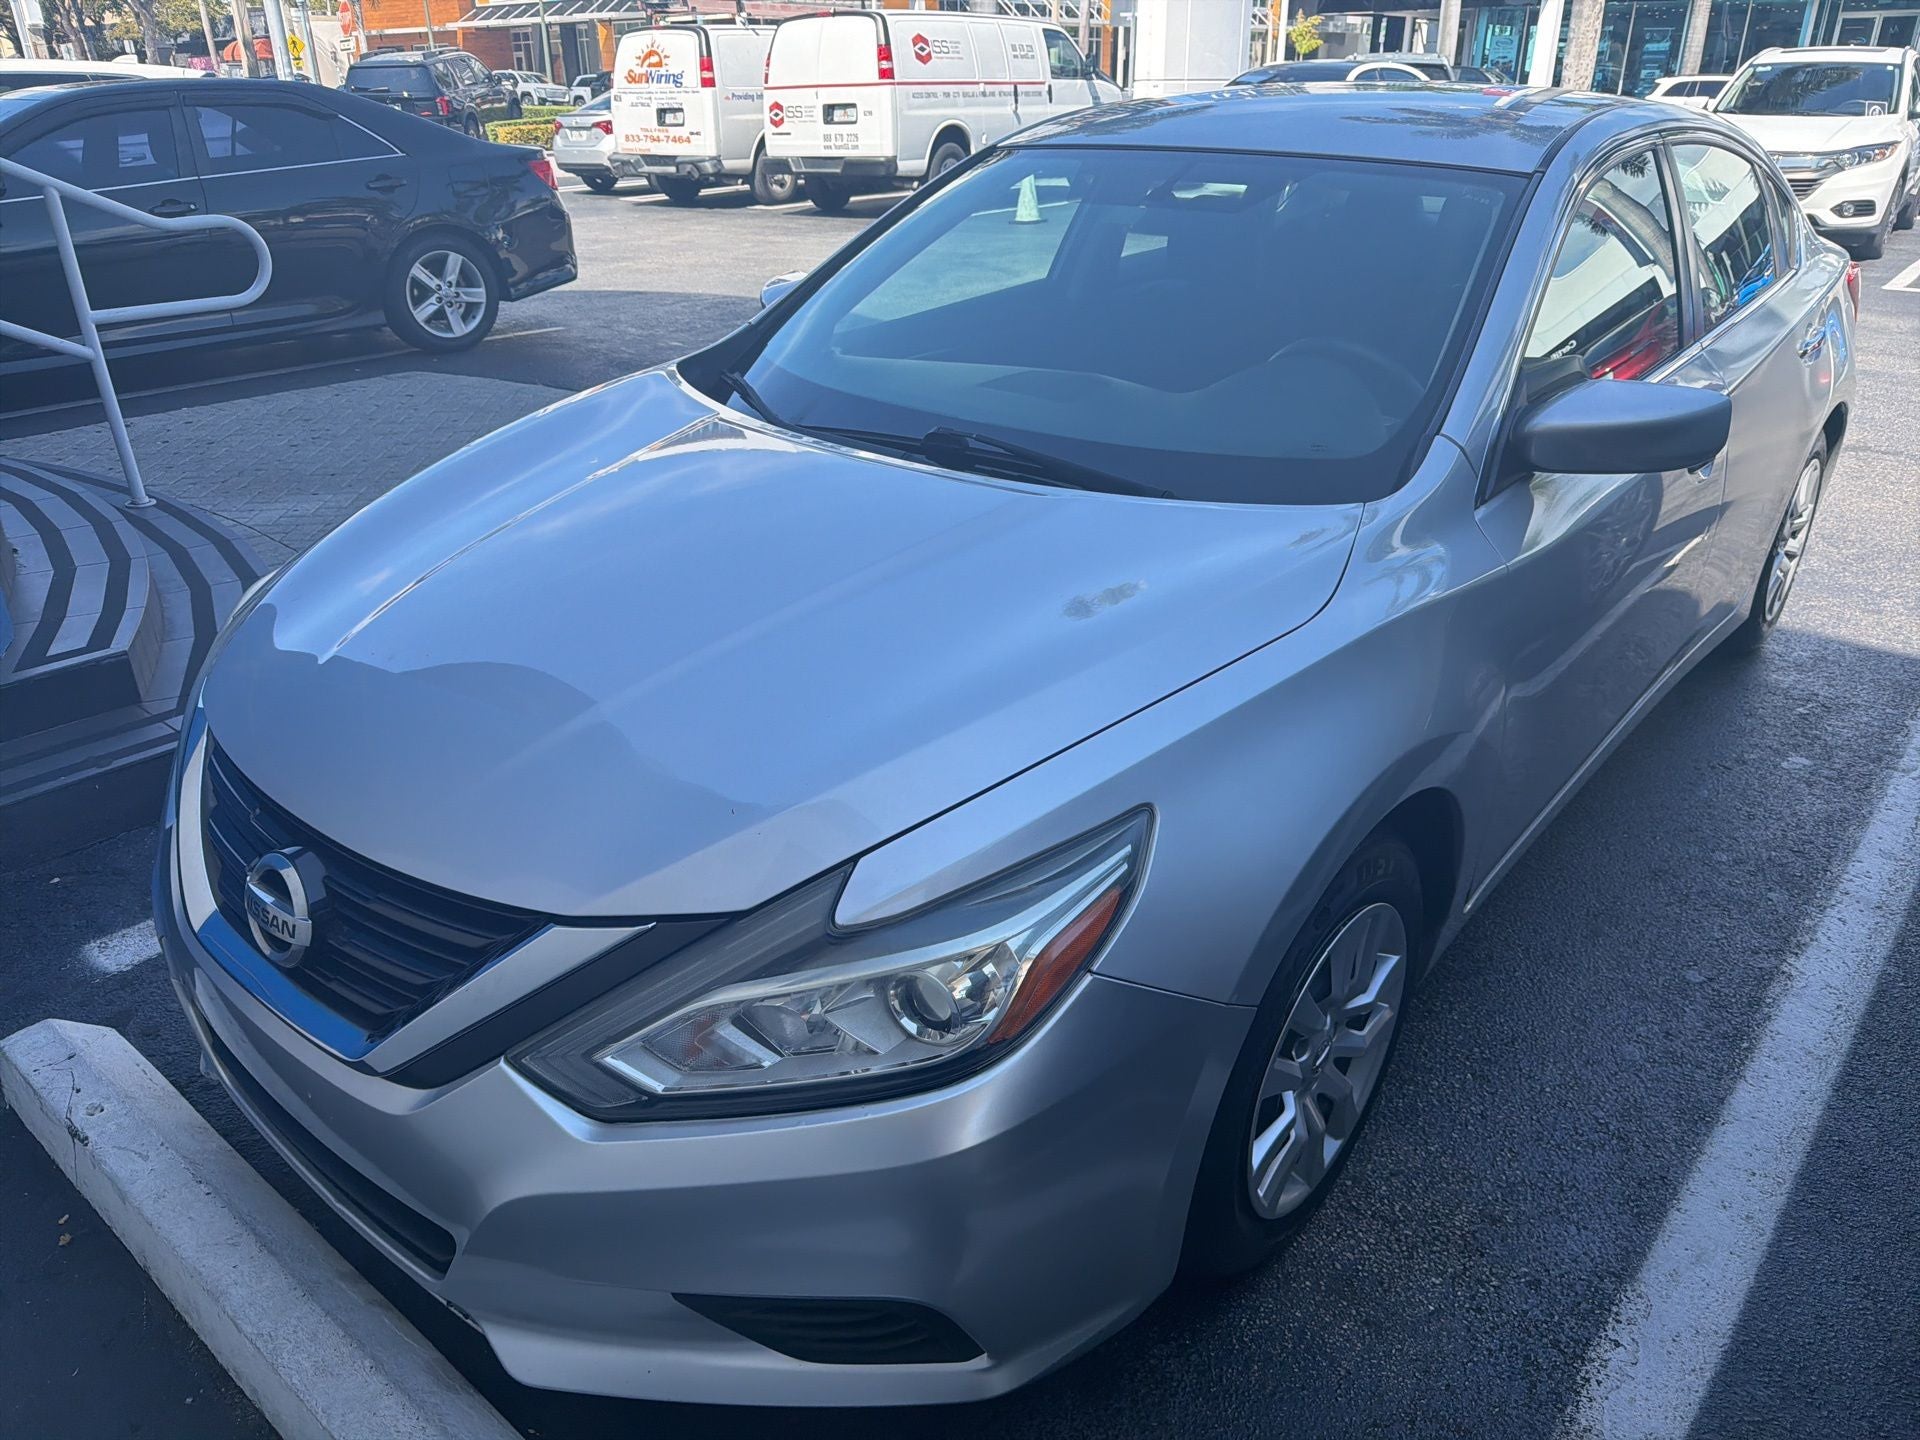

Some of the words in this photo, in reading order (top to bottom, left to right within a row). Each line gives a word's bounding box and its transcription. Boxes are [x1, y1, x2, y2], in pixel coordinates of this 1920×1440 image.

[624, 69, 684, 88] SunWiring
[731, 92, 755, 103] Providing
[624, 135, 692, 144] 833-794-7464
